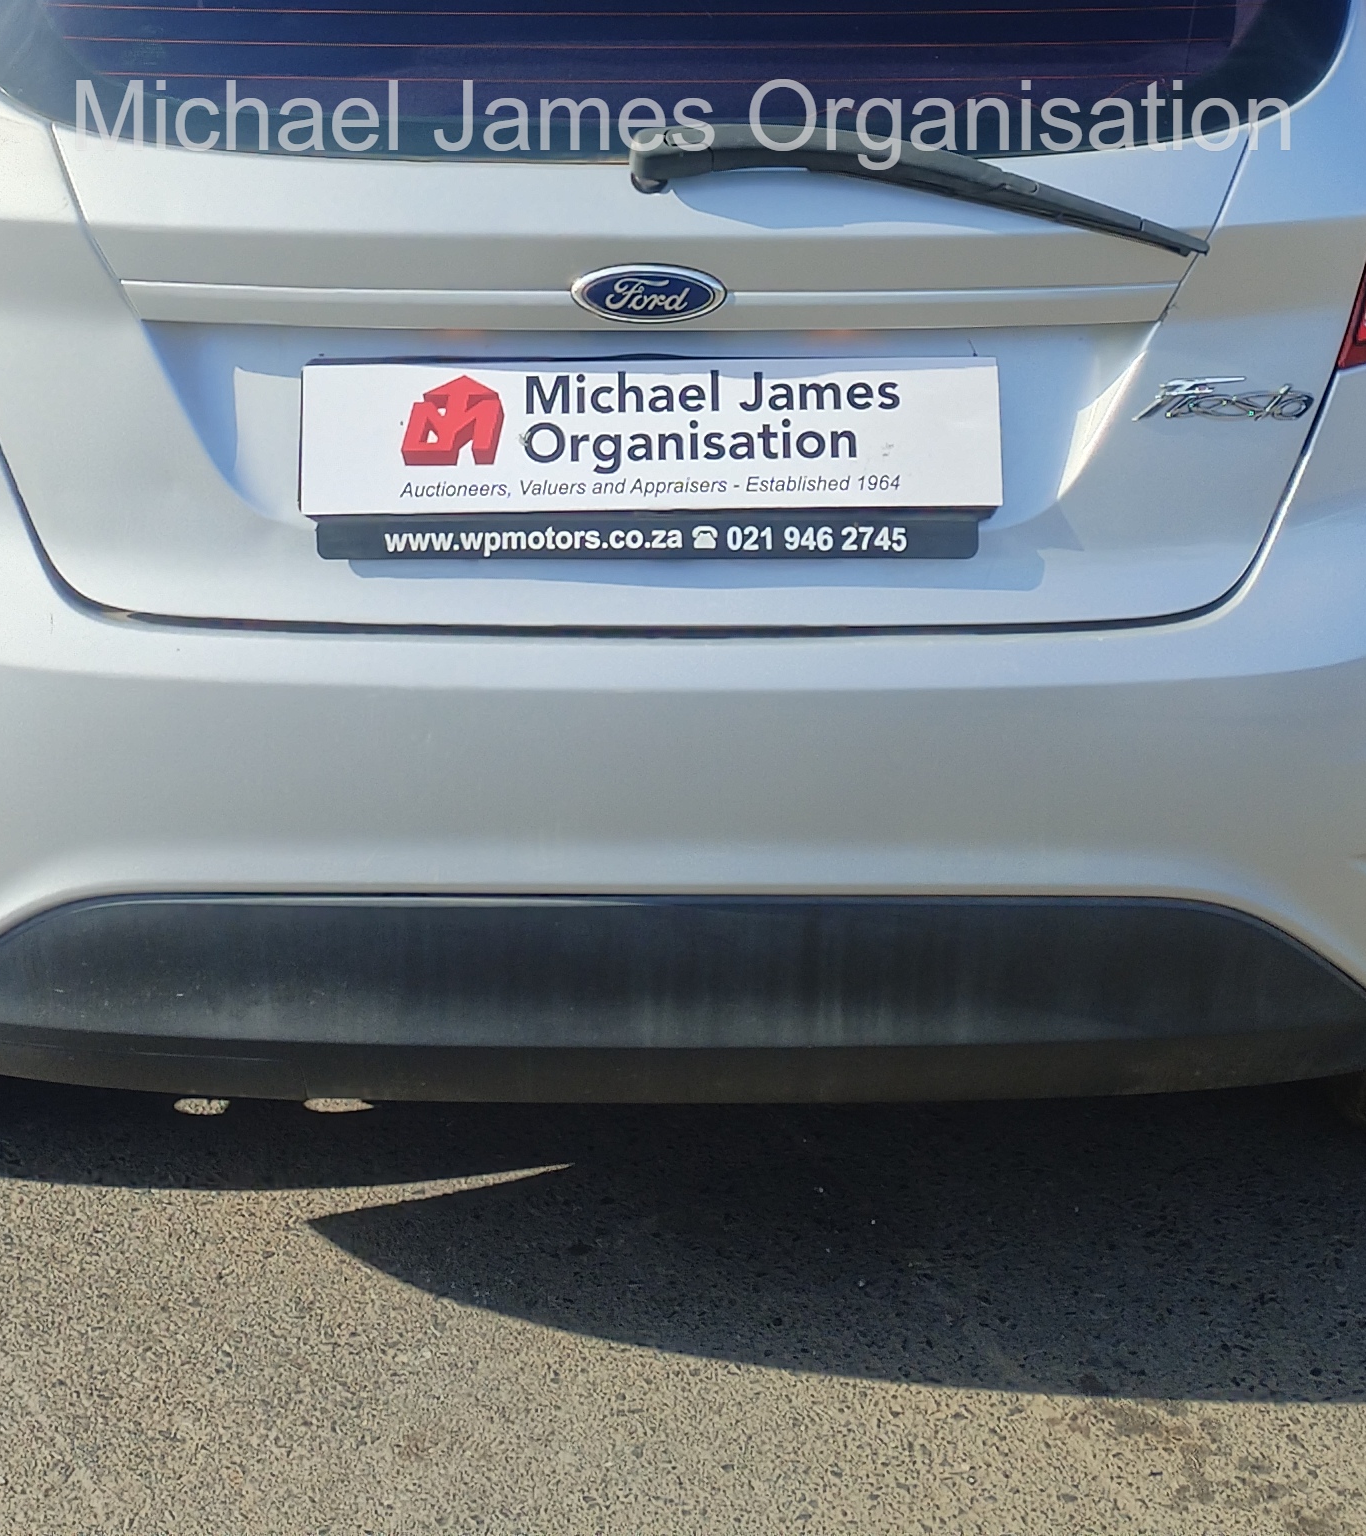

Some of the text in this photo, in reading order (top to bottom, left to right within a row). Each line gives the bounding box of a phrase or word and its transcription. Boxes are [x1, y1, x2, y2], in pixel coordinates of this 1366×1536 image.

[605, 277, 690, 312] Ford
[525, 369, 900, 415] Michael James
[522, 418, 857, 475] Organisation
[399, 481, 511, 498] Auctioneers,
[520, 479, 587, 496] Valuers
[591, 478, 627, 495] and
[629, 478, 728, 498] Appraisers
[745, 475, 851, 493] Established
[858, 474, 901, 491] 1964
[384, 525, 907, 557] www.wpmotors.co.za 021 946 2745
